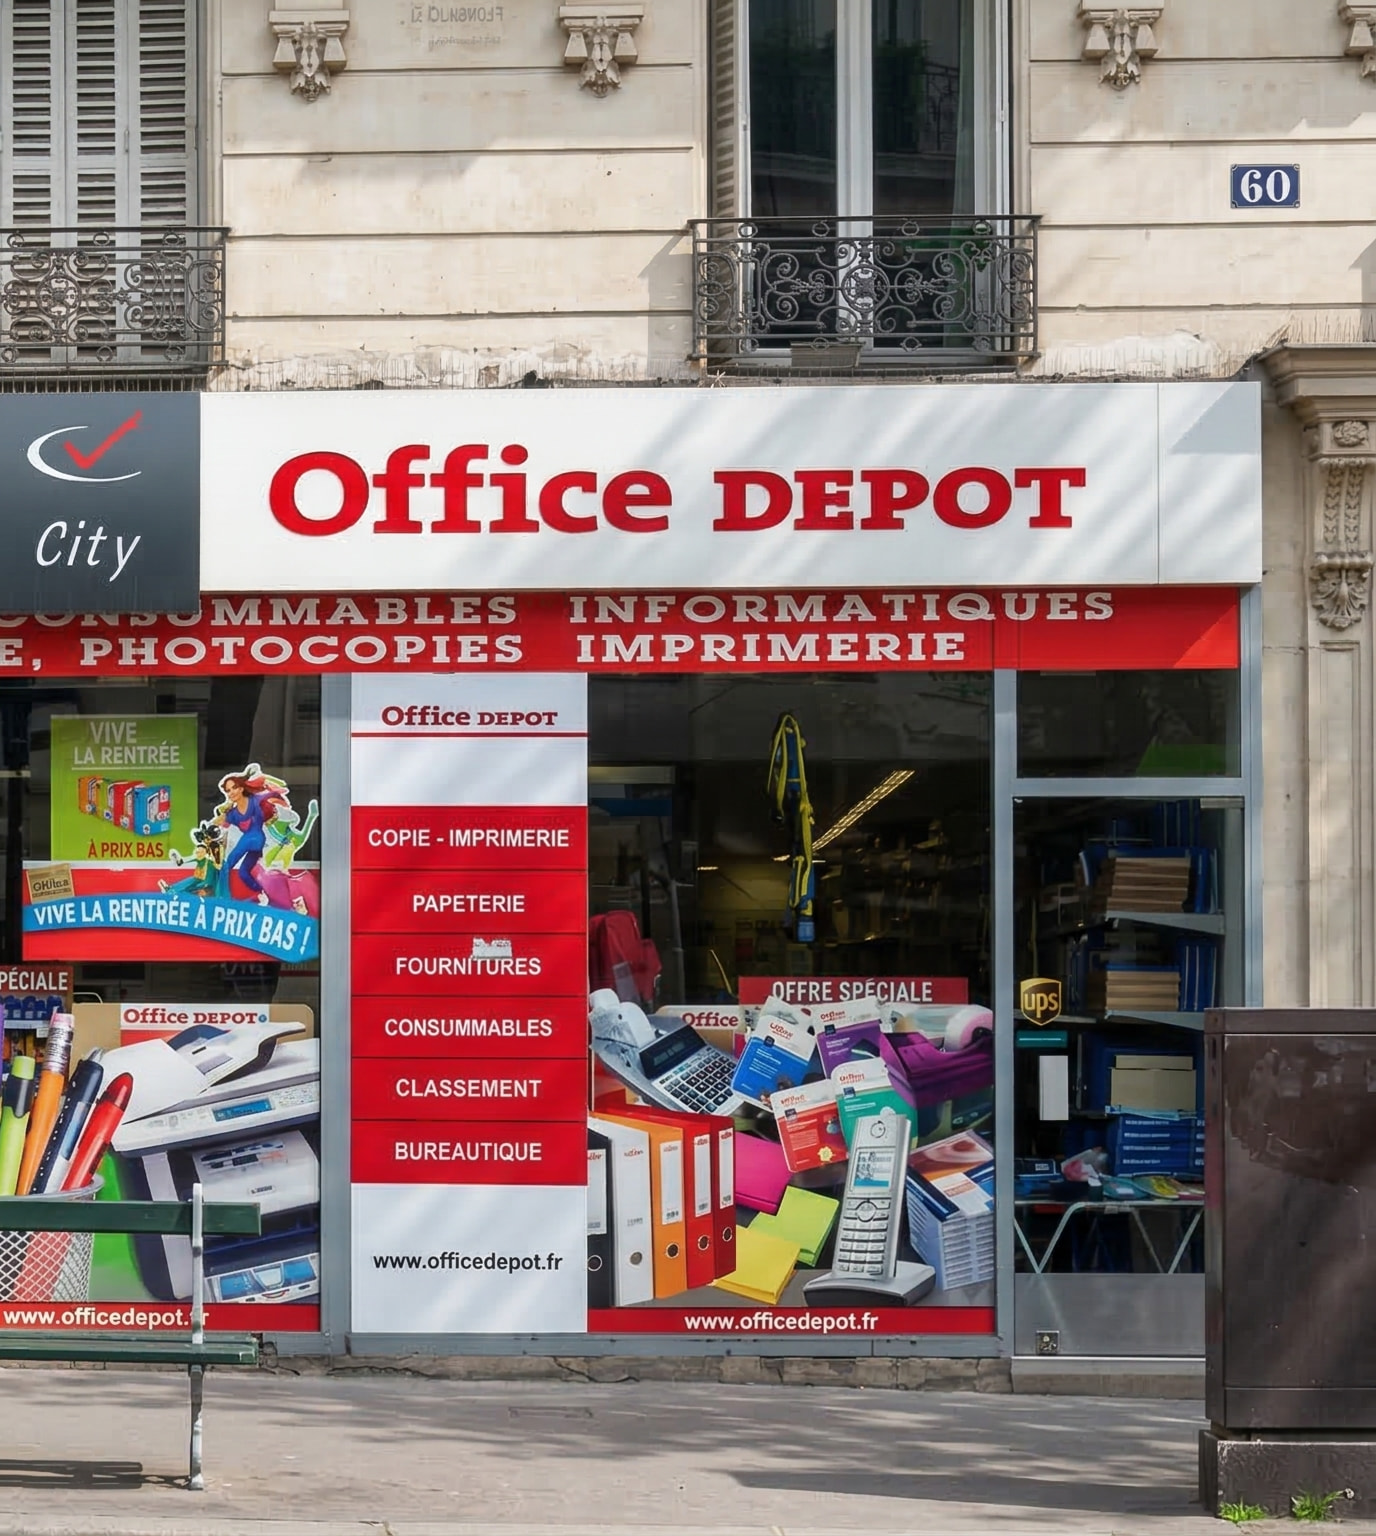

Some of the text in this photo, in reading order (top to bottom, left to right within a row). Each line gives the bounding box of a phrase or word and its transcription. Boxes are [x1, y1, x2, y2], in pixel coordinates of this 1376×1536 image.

[1240, 169, 1291, 203] 60
[268, 443, 1086, 537] Office DEPOT
[36, 520, 142, 582] City
[569, 592, 1115, 624] INFORMATIQUES
[80, 634, 523, 667] PHOTOCOPIES
[576, 631, 965, 663] IMPRIMERIE
[381, 705, 558, 726] Office DEPOT
[90, 721, 137, 744] VIVE
[74, 740, 180, 765] LA RENTRÉE
[87, 838, 164, 858] À PRIX BAS
[368, 829, 431, 847] COPIE
[449, 829, 569, 847] IMPRIMERIE
[412, 895, 525, 913] PAPETERIE
[33, 895, 312, 955] VIVE LA RENTRÉE À PRIX BAS !
[395, 956, 542, 976] FOURNITURES
[772, 977, 933, 1002] OFFRE SPÉCIALE
[123, 1007, 258, 1024] Office DEPOT
[1024, 992, 1059, 1019] ups
[384, 1018, 553, 1037] CONSUMMABLES
[682, 1011, 739, 1027] Office
[395, 1078, 542, 1098] CLASSEMENT
[394, 1142, 542, 1162] BUREAUTIQUE
[373, 1251, 563, 1274] www.officedepot.fr
[684, 1310, 879, 1334] www.officedepot.fr
